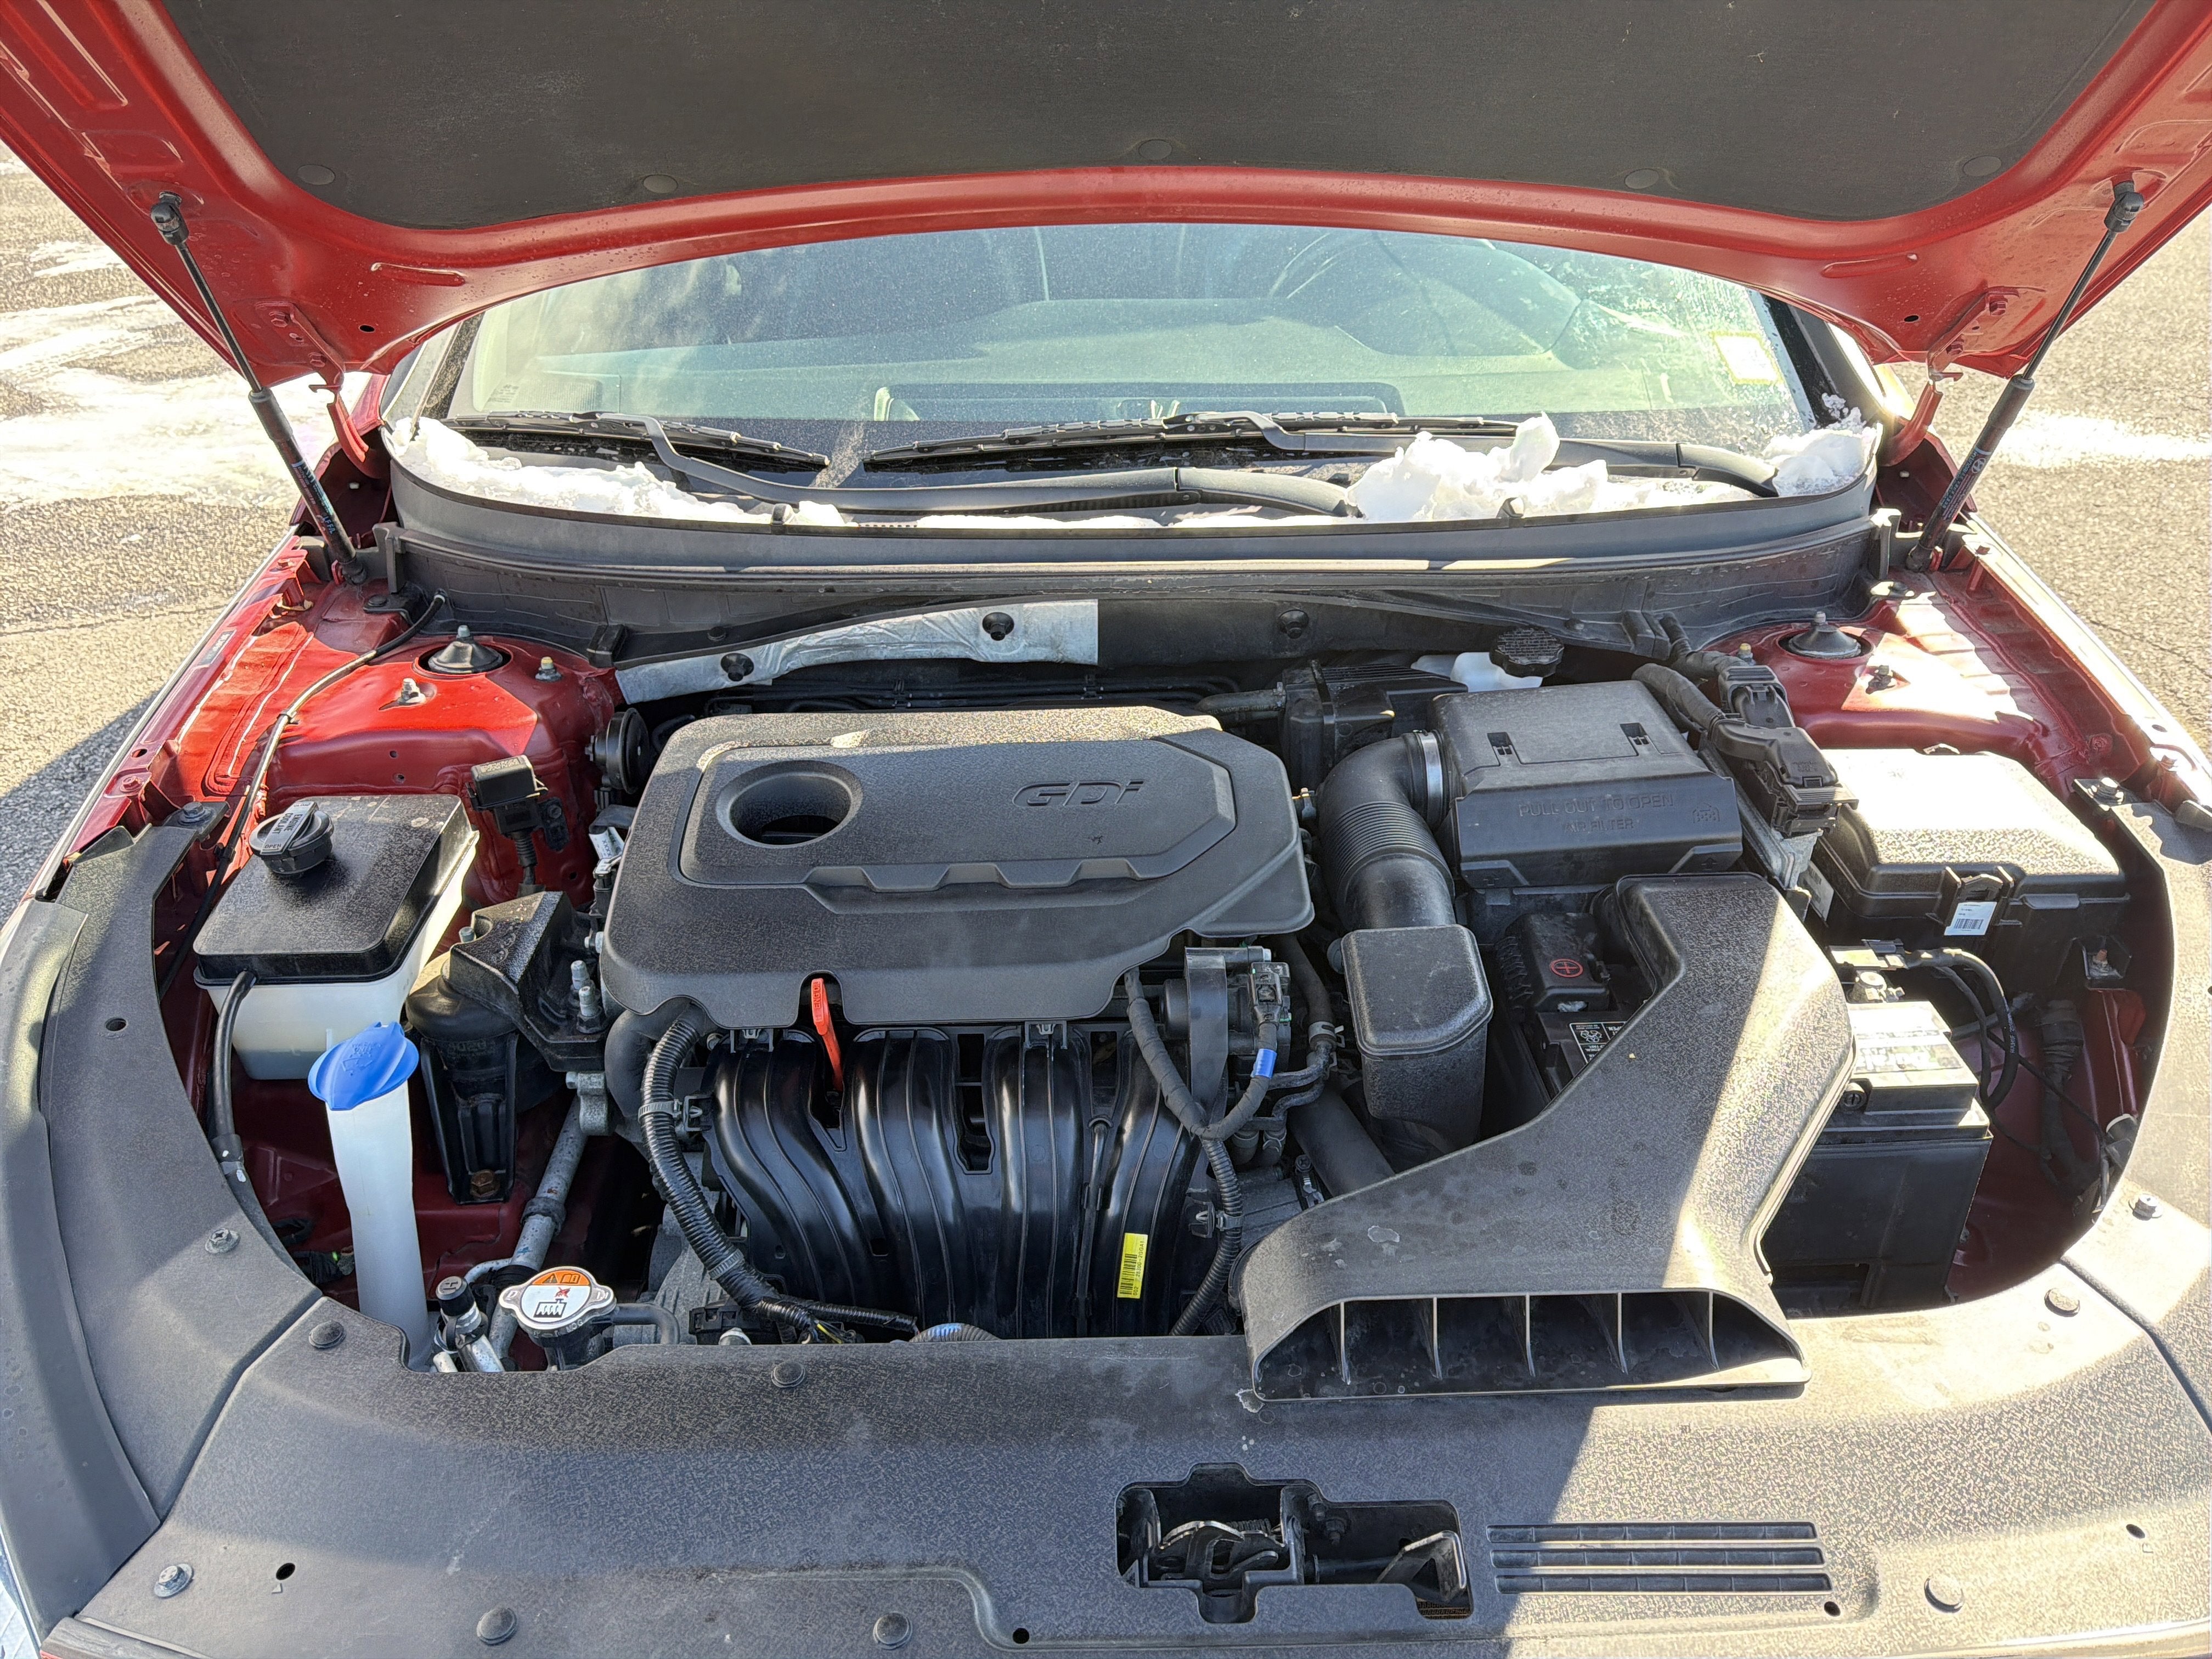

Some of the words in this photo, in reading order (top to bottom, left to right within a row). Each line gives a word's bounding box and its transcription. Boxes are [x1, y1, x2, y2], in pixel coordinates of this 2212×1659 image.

[1519, 803, 1559, 816] PULL
[1565, 798, 1596, 814] OUT
[1603, 795, 1624, 811] TO
[1629, 794, 1674, 810] OPEN
[272, 812, 294, 834] COOLANT
[284, 814, 303, 832] ENGINE
